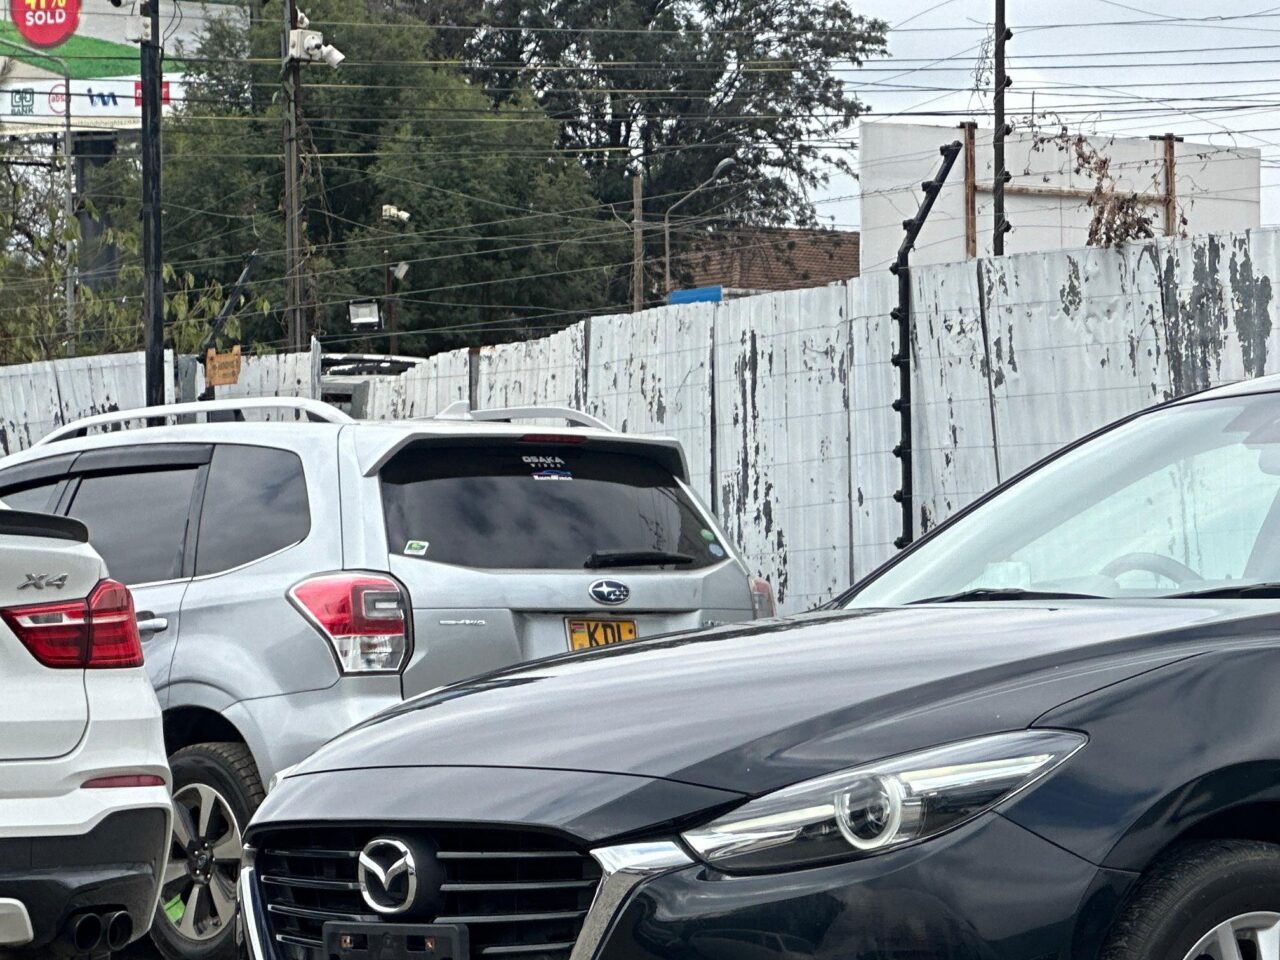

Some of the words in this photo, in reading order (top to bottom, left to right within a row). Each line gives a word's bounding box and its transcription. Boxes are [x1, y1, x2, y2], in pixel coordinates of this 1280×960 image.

[25, 8, 66, 26] SOLD
[521, 455, 566, 465] OSAKA
[16, 572, 69, 590] X4
